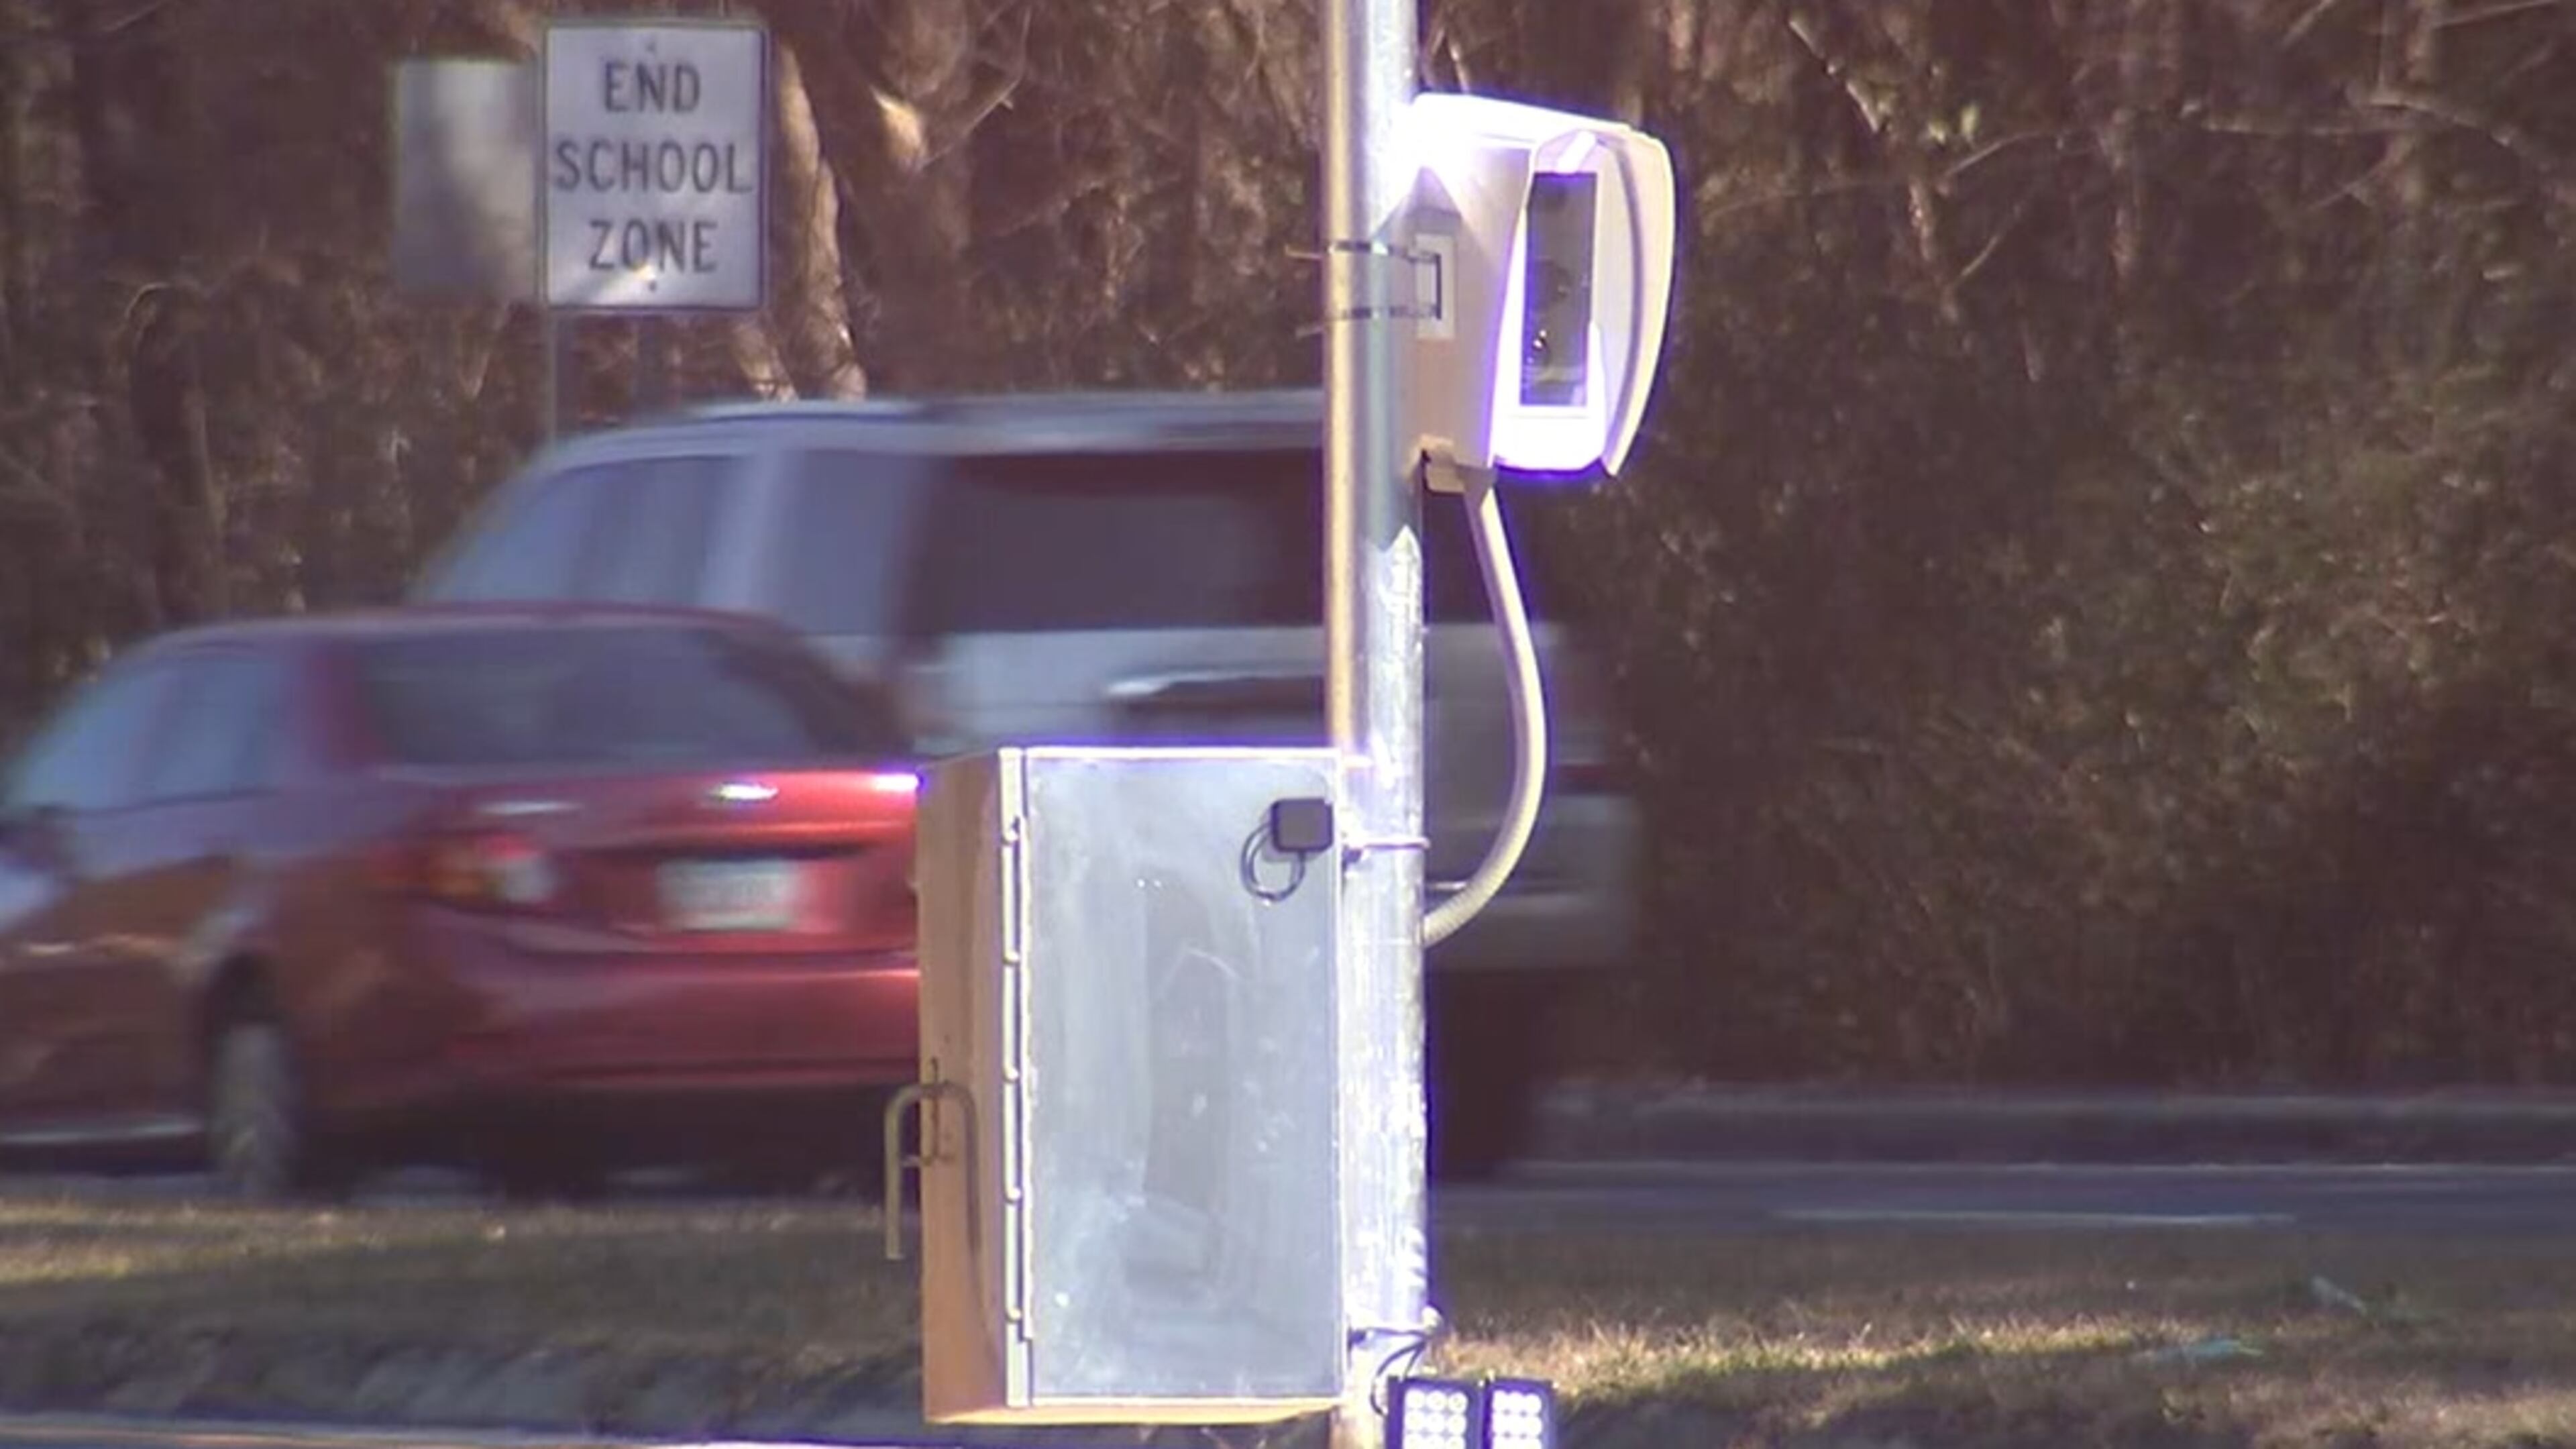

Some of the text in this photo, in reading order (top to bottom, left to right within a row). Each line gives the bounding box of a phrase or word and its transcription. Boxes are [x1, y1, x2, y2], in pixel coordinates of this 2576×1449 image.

[603, 61, 701, 113] END
[554, 140, 753, 194] SCHOOL
[588, 218, 718, 272] ZONE
